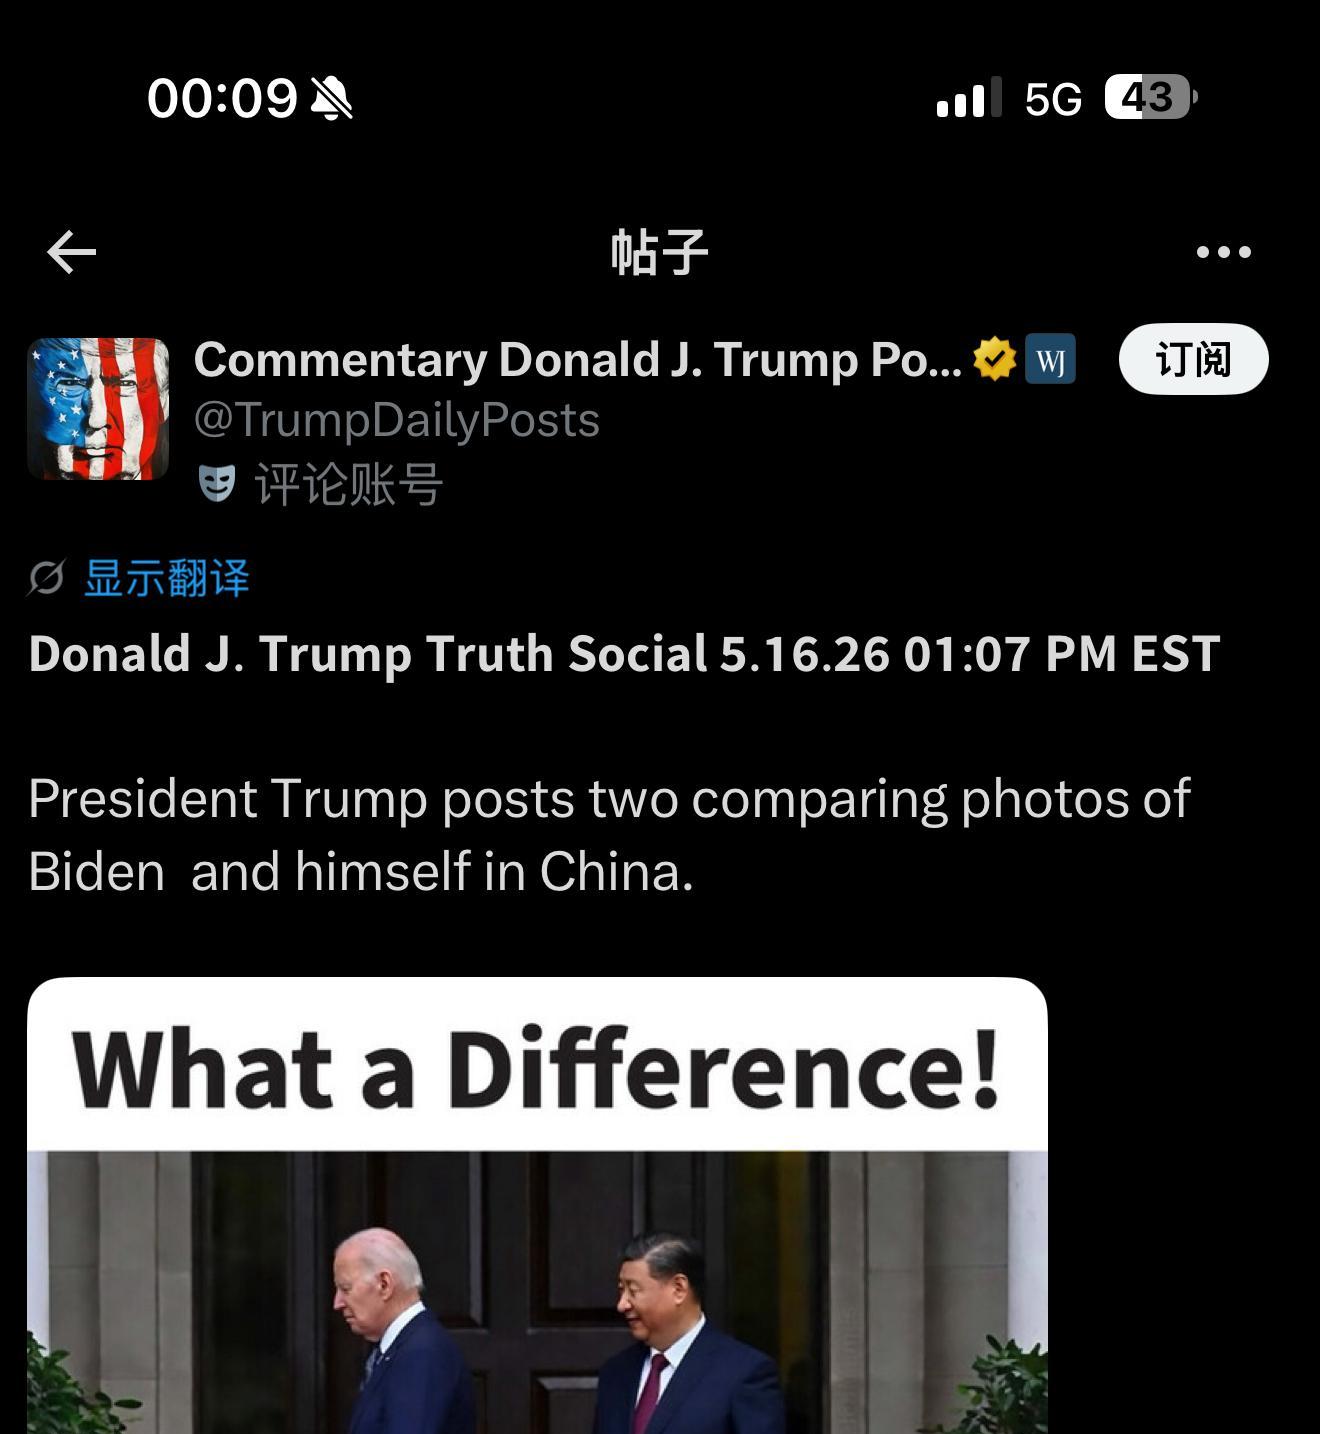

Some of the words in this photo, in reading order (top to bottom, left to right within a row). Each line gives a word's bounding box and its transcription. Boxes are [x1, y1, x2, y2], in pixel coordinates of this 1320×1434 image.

[148, 78, 297, 118] 00:09
[1026, 82, 1081, 116] 5G
[1122, 81, 1172, 112] 43
[612, 228, 708, 276] 帖子
[195, 341, 488, 386] Commentary
[501, 340, 658, 377] Donald
[671, 342, 701, 377] J.
[714, 342, 858, 386] Trump
[1036, 350, 1065, 377] WJ
[1156, 341, 1230, 377] 订阅
[195, 400, 600, 446] @TrumpDailyPosts
[255, 462, 443, 506] 评论账号
[85, 559, 249, 598] 显示翻译
[31, 633, 189, 672] Donald
[205, 635, 243, 672] J.
[259, 635, 411, 683] Trump
[426, 633, 552, 672] Truth
[569, 633, 707, 672] Social
[720, 636, 889, 672] 5.16.26
[905, 636, 1030, 672] 01:07
[1048, 635, 1115, 671] PM
[1134, 635, 1220, 672] EST
[31, 777, 257, 818] President
[271, 778, 426, 828] Trump
[445, 781, 574, 828] posts
[589, 781, 678, 818] two
[693, 777, 948, 828] comparing
[964, 777, 1129, 828] photos
[1144, 776, 1191, 818] of
[31, 850, 163, 891] Biden
[192, 850, 278, 891] and
[298, 849, 471, 891] himself
[486, 850, 524, 890] in
[542, 850, 692, 891] China.
